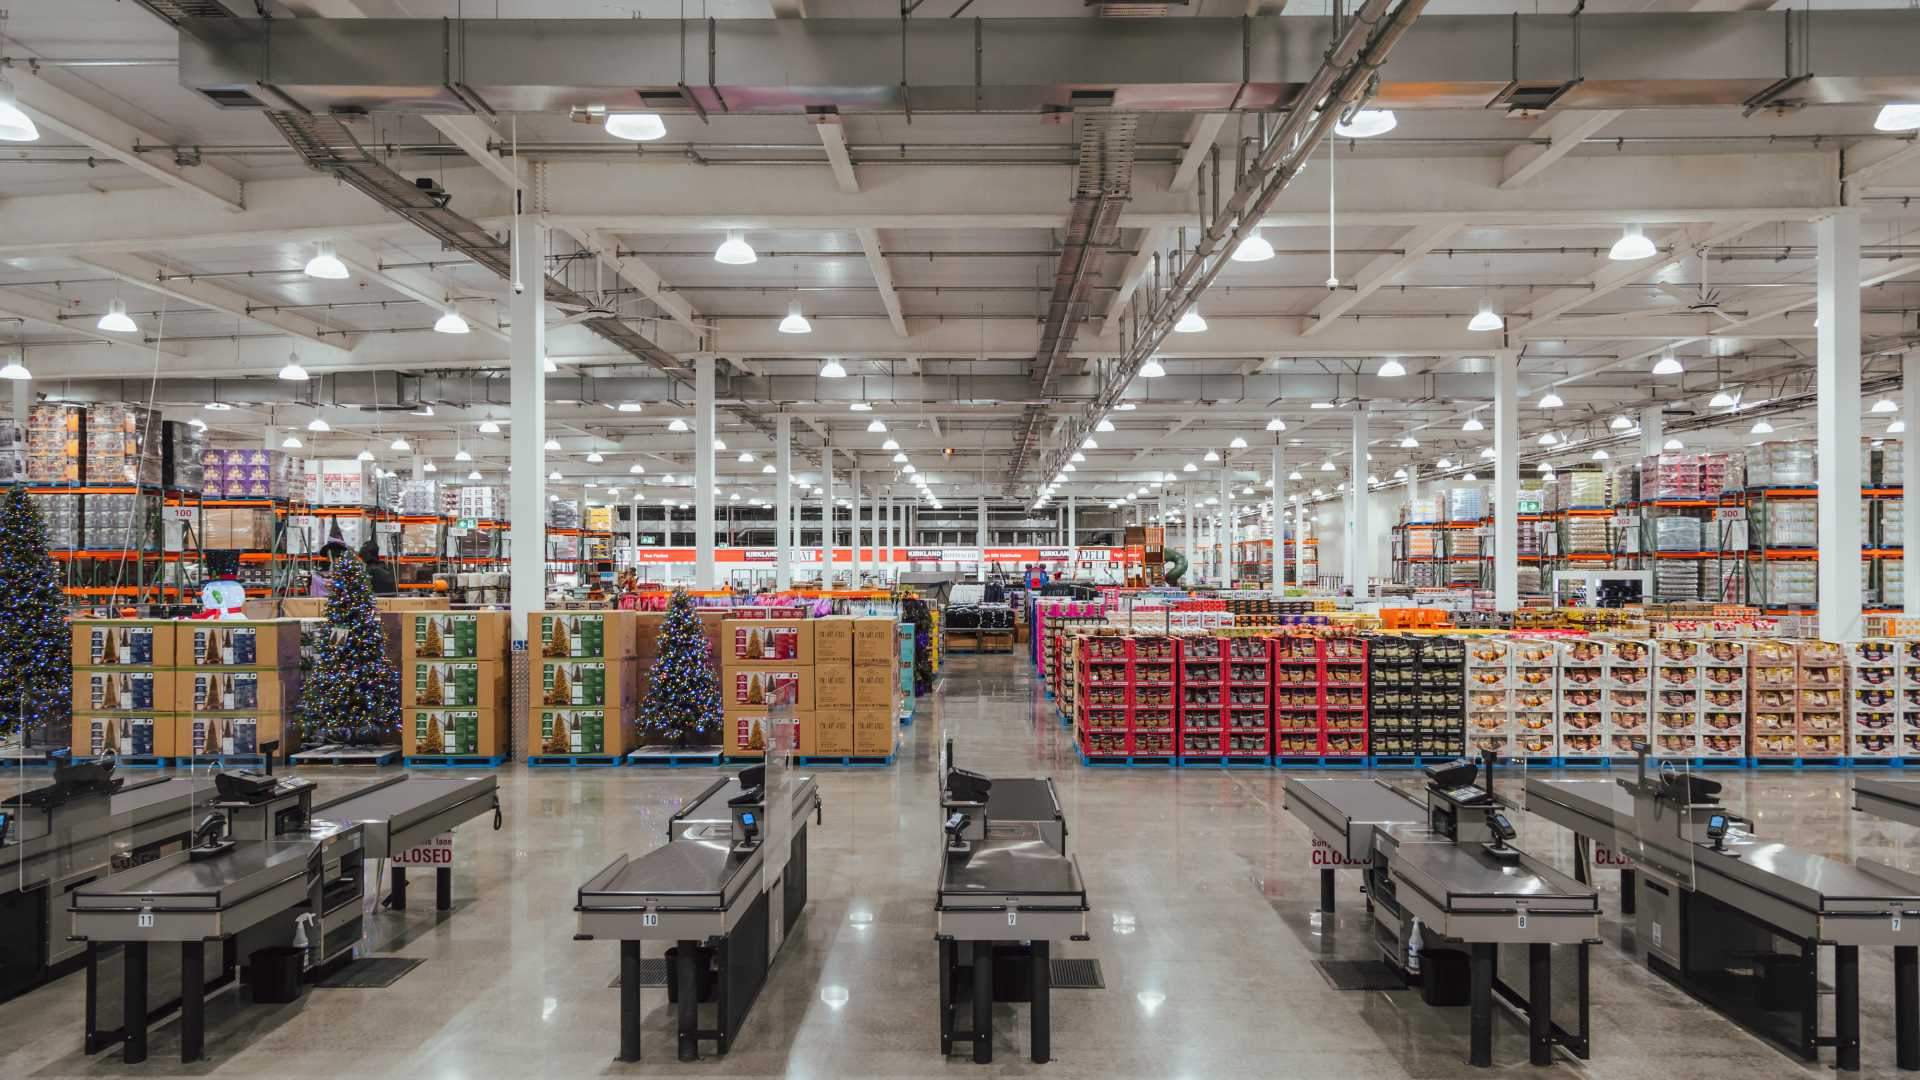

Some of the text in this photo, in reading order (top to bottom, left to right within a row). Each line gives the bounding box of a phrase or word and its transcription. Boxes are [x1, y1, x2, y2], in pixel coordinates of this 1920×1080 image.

[176, 509, 192, 517] 100
[1721, 510, 1738, 518] 300
[141, 915, 152, 926] 11
[646, 914, 657, 925] 10
[1519, 916, 1525, 928] 8
[1893, 919, 1899, 929] 7
